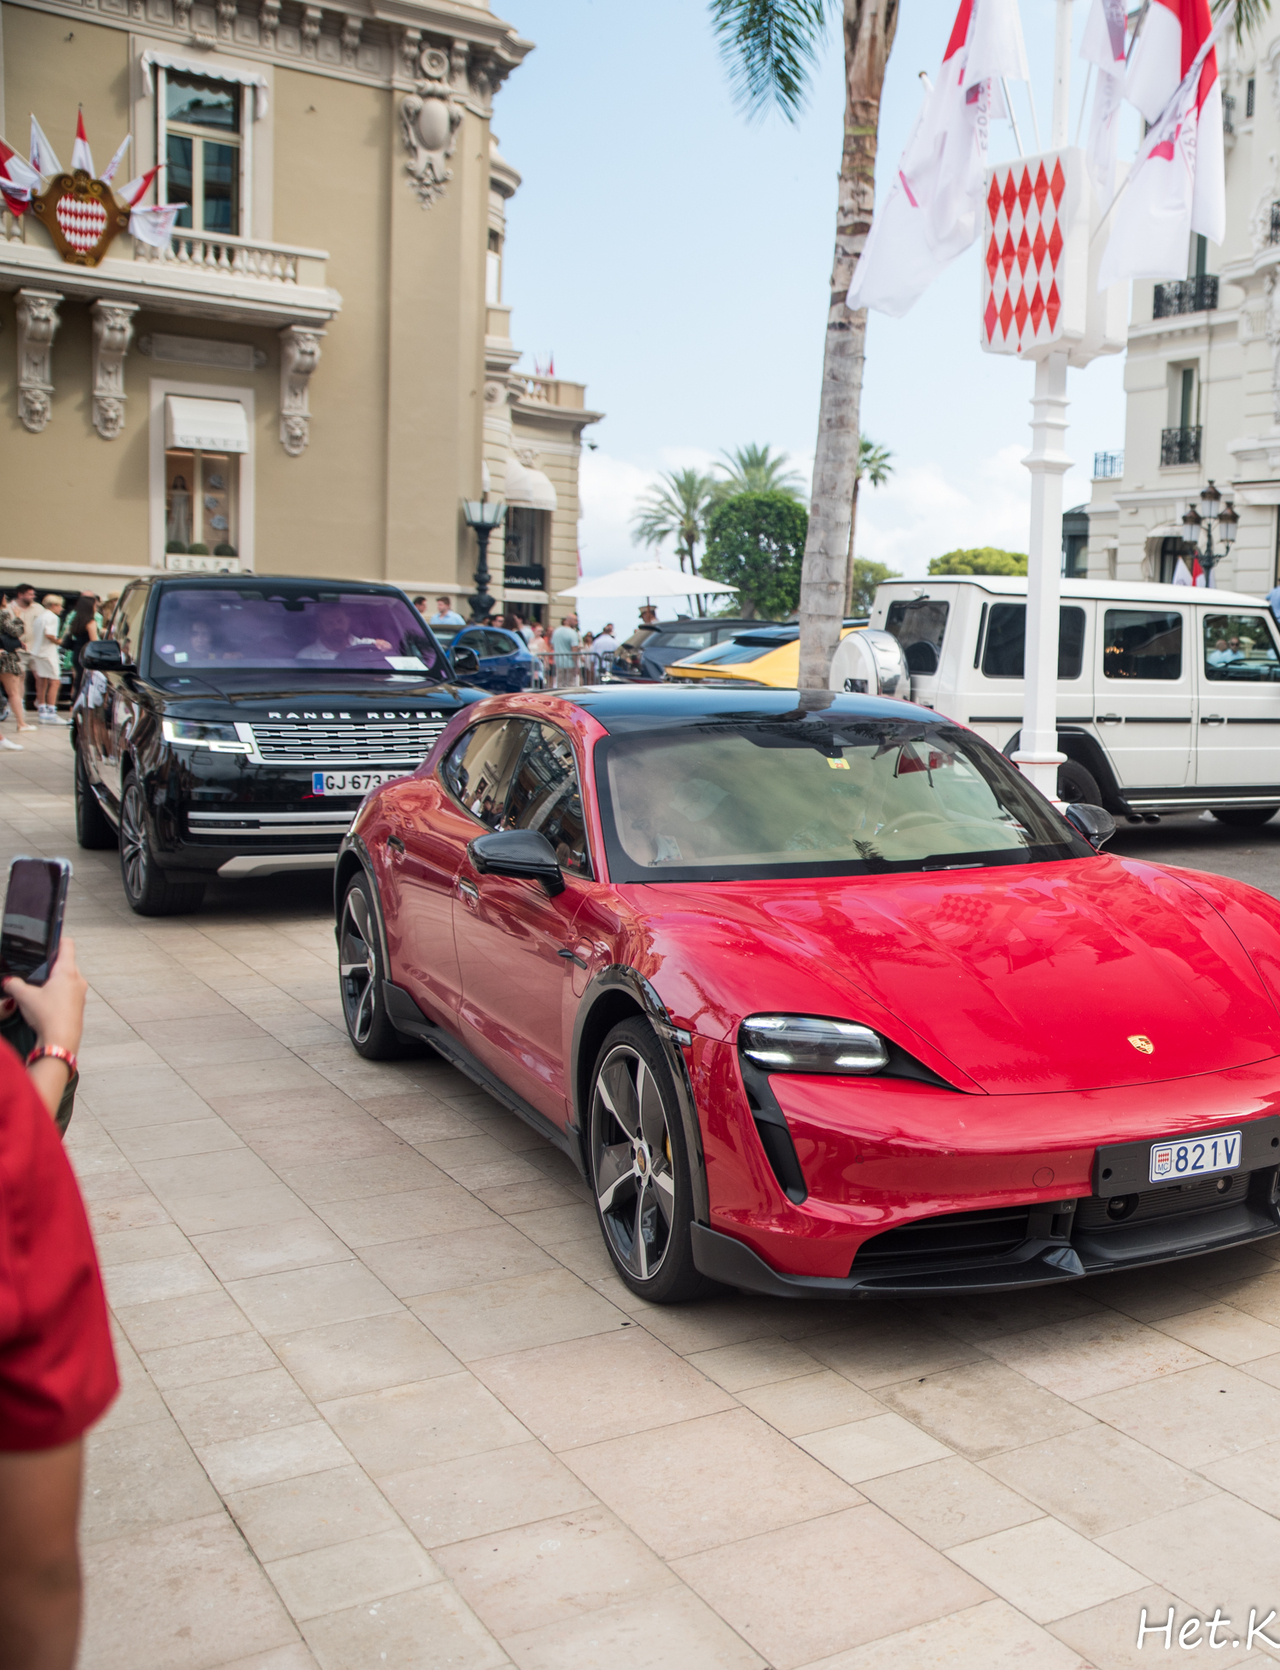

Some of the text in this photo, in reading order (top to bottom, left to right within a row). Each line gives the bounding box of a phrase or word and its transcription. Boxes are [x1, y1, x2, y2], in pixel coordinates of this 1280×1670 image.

[268, 711, 443, 720] RANGE ROVER
[1175, 1137, 1236, 1172] 821V
[1158, 1163, 1169, 1171] MC
